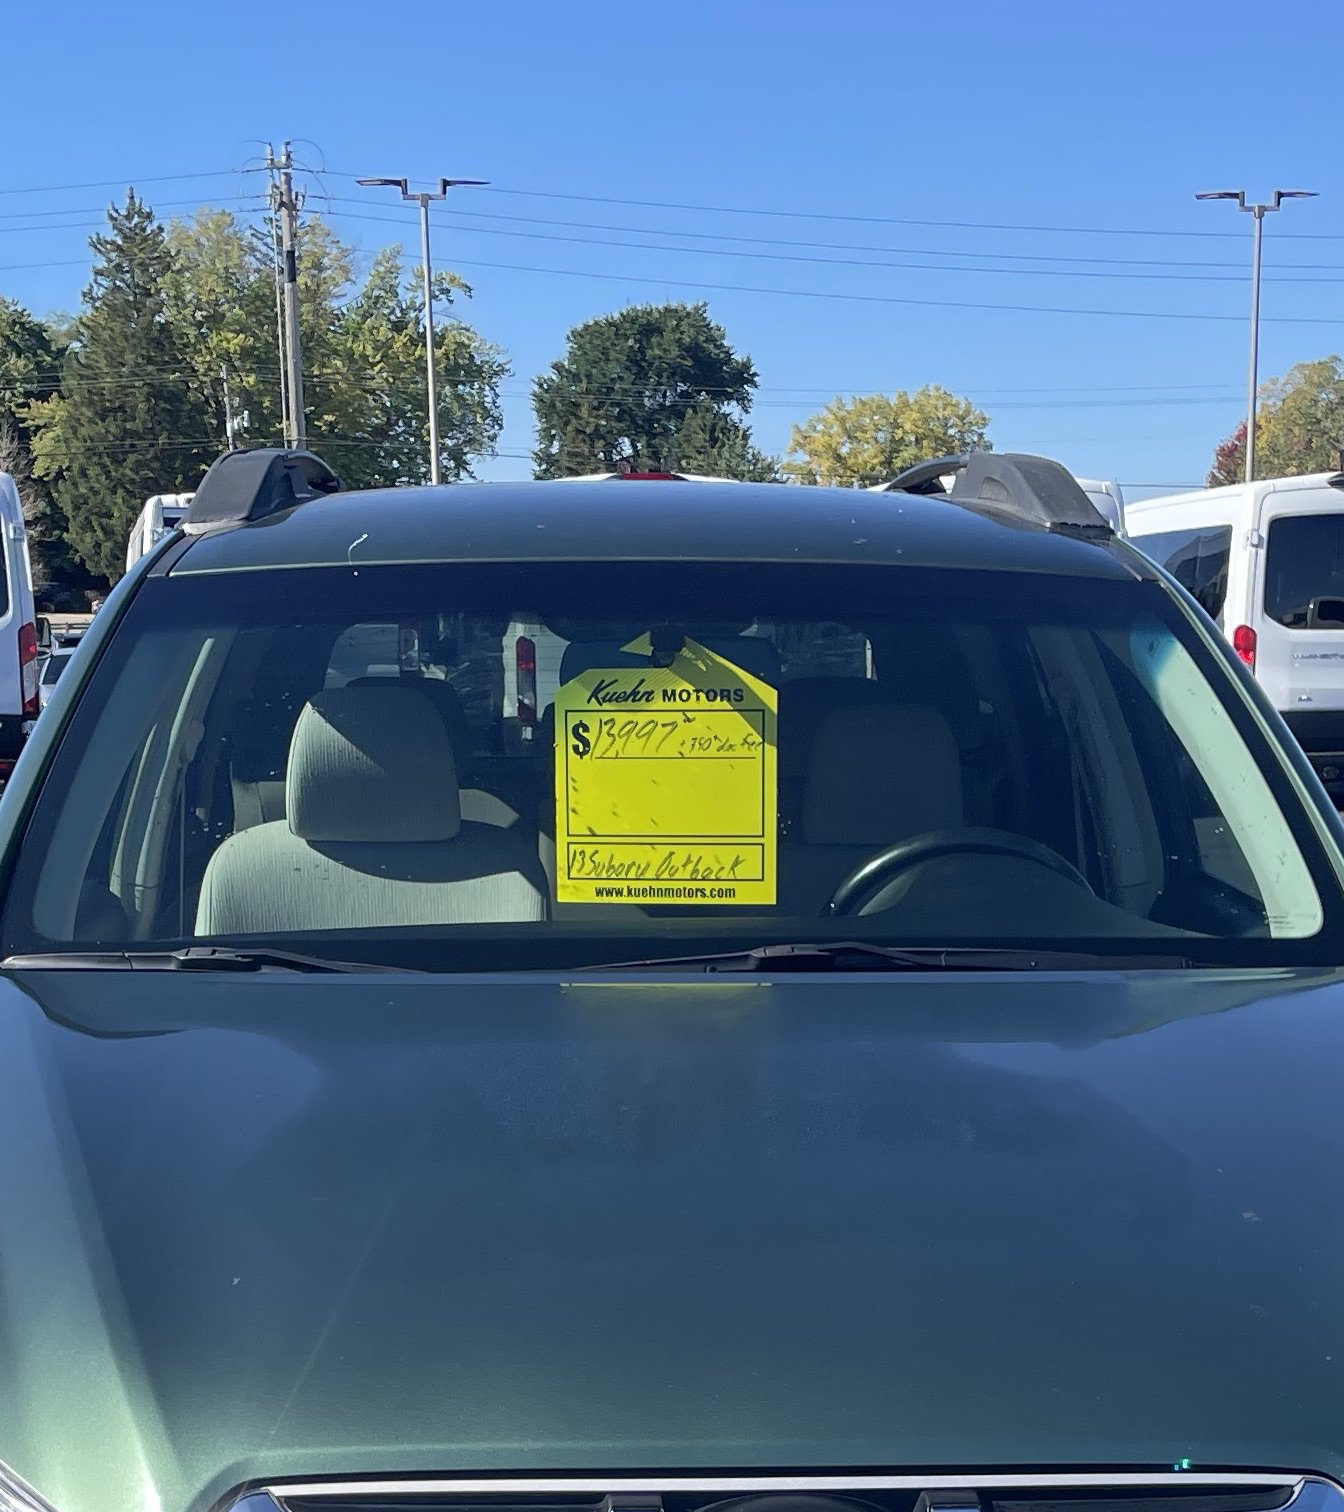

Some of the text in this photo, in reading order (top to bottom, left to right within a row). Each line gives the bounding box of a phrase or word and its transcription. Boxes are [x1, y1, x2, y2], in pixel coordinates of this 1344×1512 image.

[587, 678, 745, 706] Kuehn MOTORS
[656, 851, 746, 880] Outback
[595, 886, 736, 899] www.kuehnmotors.com
